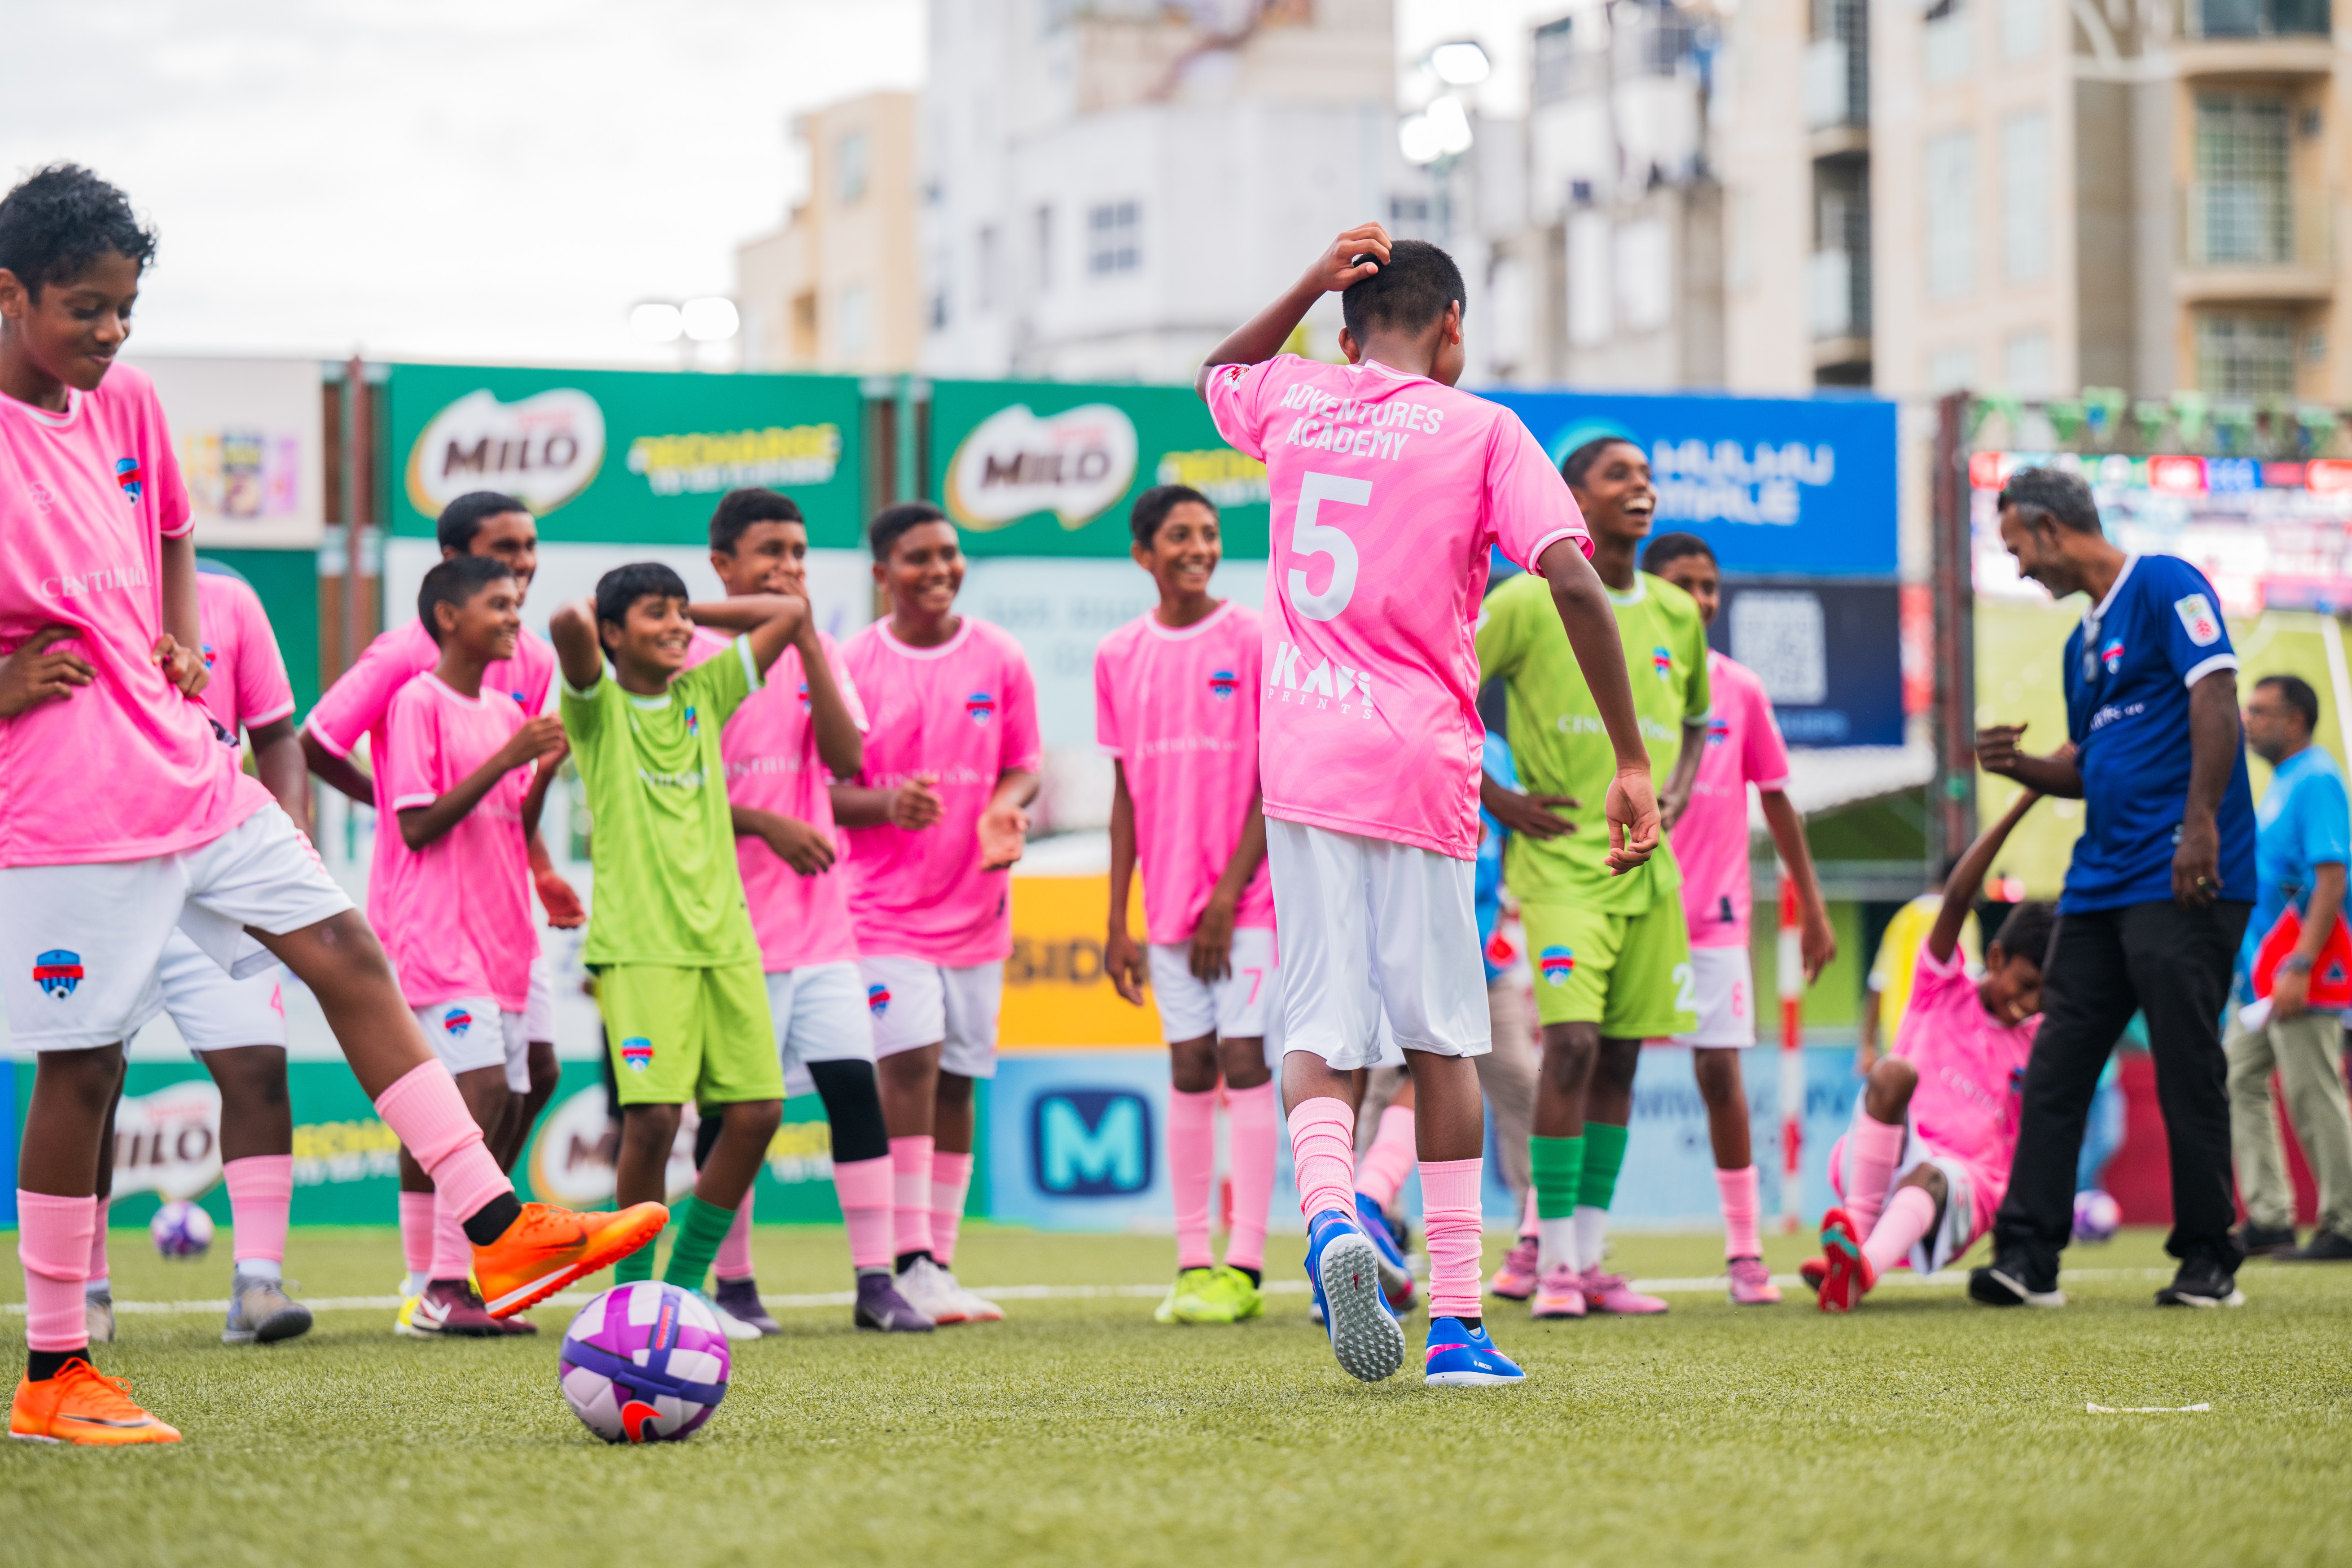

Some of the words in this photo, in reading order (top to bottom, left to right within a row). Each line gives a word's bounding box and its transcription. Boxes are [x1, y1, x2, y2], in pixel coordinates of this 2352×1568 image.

[1280, 383, 1444, 434] ADVENTURES
[441, 431, 580, 479] MILO
[1286, 417, 1410, 461] ACADEMY
[980, 448, 1113, 489] MILO
[1288, 471, 1373, 621] 5
[1268, 687, 1372, 720] PRINTS
[1242, 967, 1264, 1006] 7
[1672, 961, 1696, 1013] 2
[112, 1122, 213, 1170] ILO
